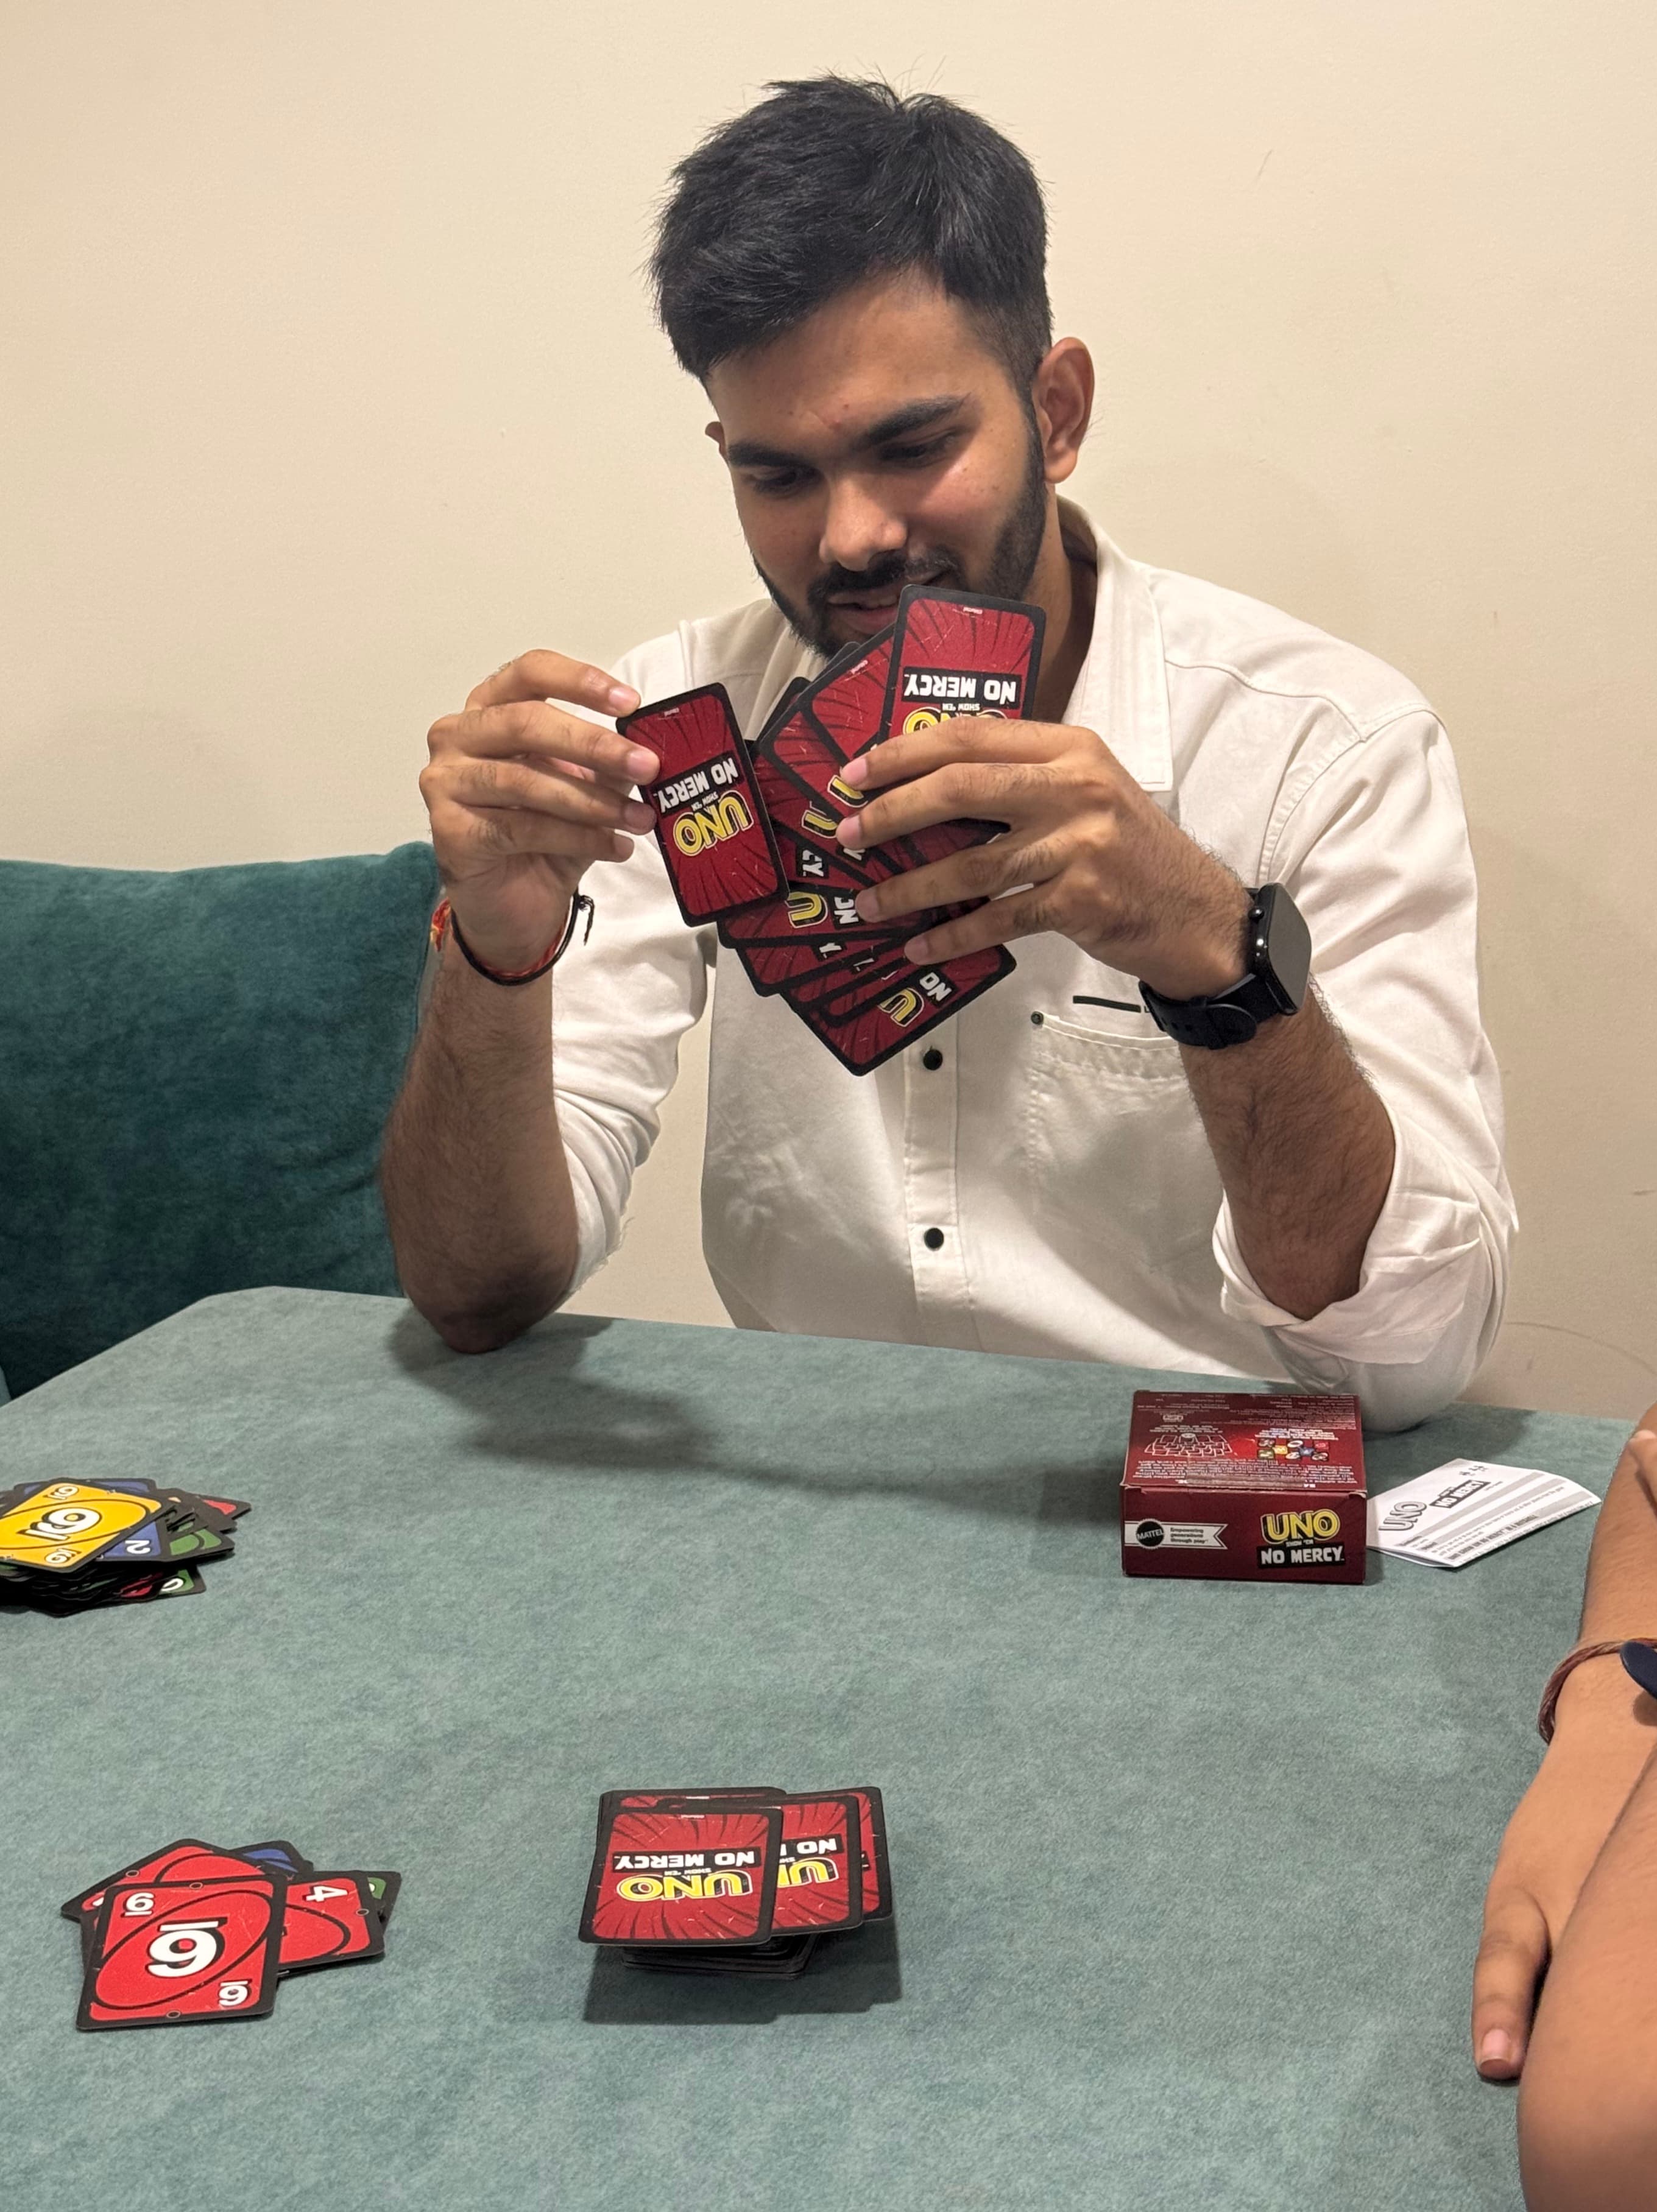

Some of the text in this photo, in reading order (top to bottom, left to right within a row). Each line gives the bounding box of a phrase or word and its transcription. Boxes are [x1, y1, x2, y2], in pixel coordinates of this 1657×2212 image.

[904, 674, 1017, 705] NO MERCY
[958, 703, 980, 711] SHOW
[656, 757, 739, 814] NO MERCY
[702, 792, 719, 804] SHOW
[673, 790, 754, 856] UNO
[919, 971, 952, 1002] NO
[1435, 1497, 1457, 1507] NO
[1378, 1501, 1427, 1532] UNO
[1137, 1529, 1164, 1540] MATTEL
[1260, 1509, 1340, 1545] UNO
[125, 1540, 150, 1554] 2
[1260, 1546, 1343, 1565] NO MERCY
[796, 1838, 837, 1854] NO
[615, 1851, 755, 1870] NO MERCY
[306, 1886, 348, 1902] 4
[617, 1869, 753, 1901] UNO
